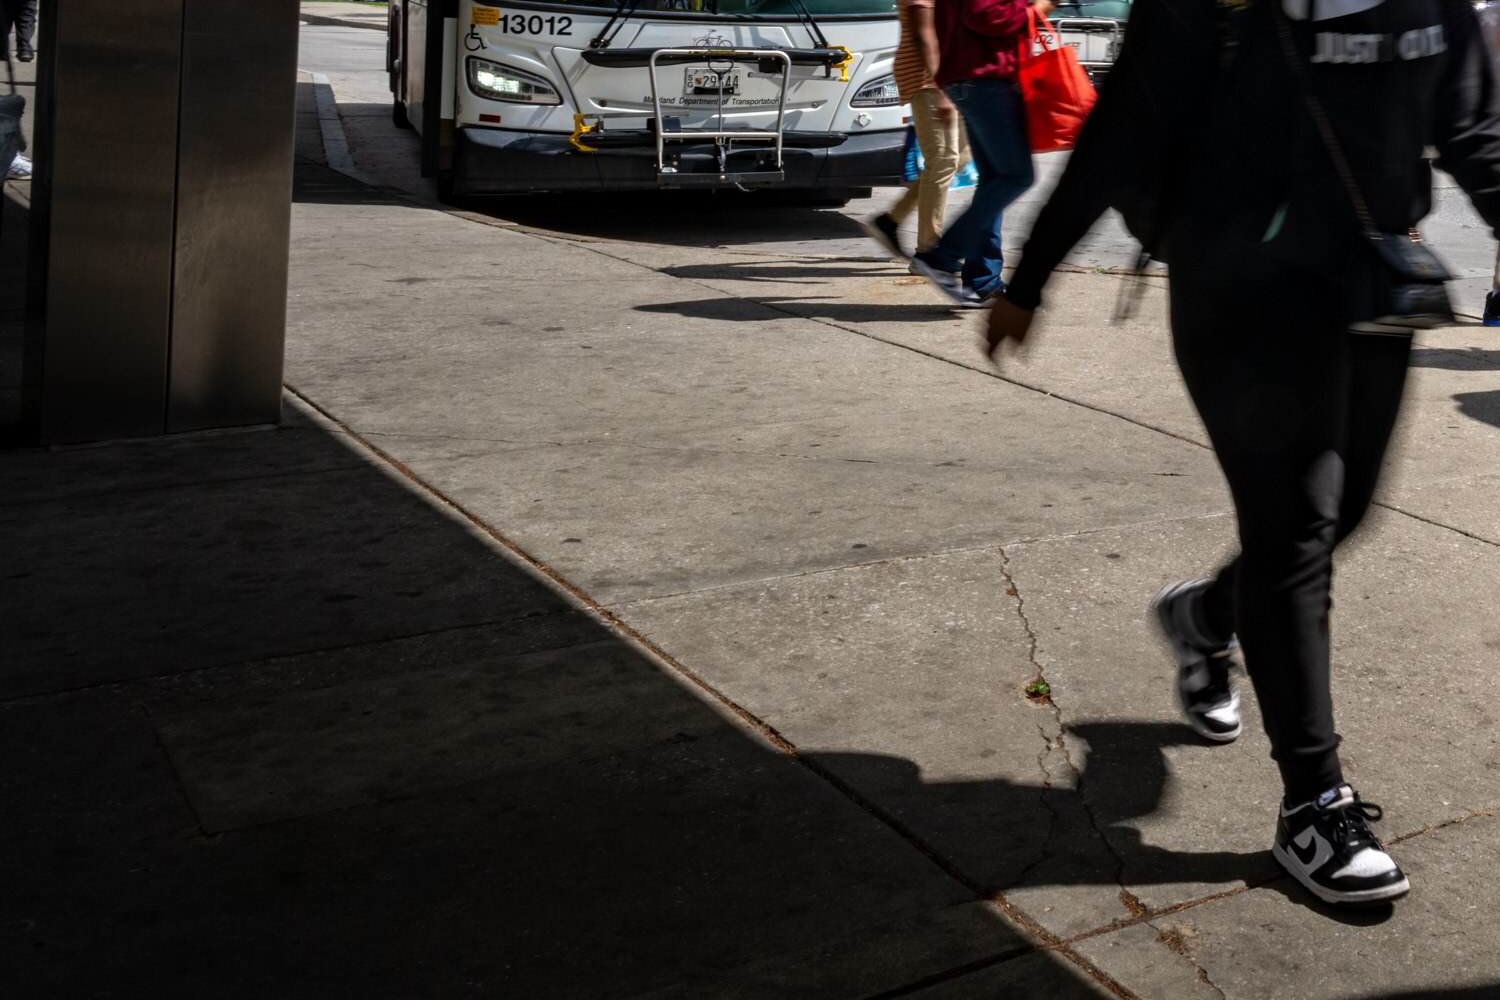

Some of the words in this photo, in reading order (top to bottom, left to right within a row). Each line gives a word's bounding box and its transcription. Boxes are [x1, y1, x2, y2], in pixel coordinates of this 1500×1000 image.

[499, 14, 573, 36] 13012
[702, 75, 739, 89] 2944
[643, 95, 676, 105] Maland
[679, 97, 719, 107] Department
[732, 97, 780, 107] Transportation
